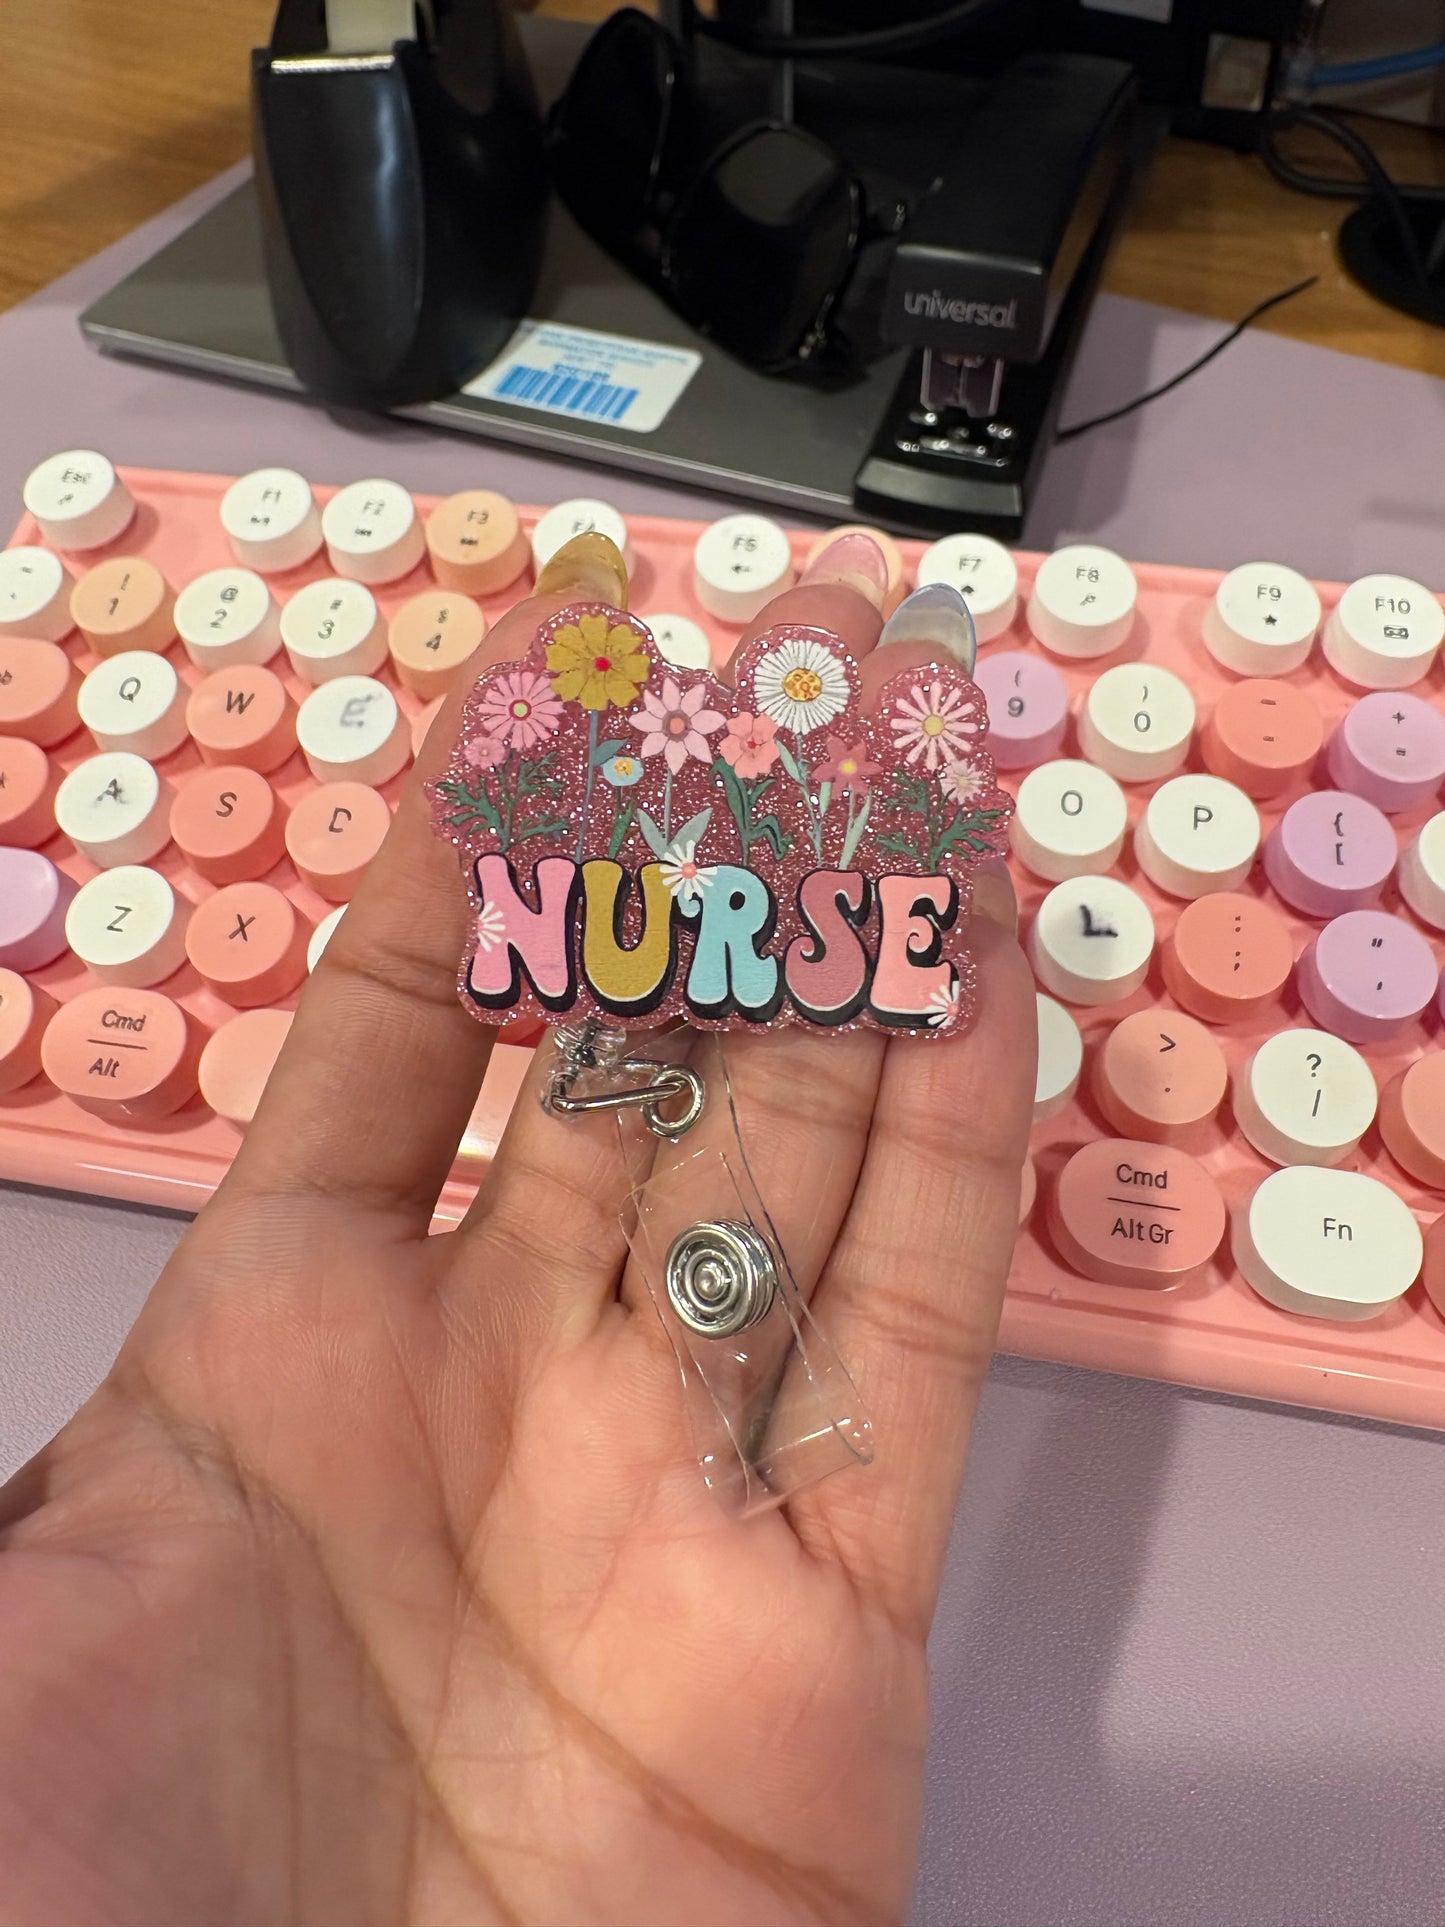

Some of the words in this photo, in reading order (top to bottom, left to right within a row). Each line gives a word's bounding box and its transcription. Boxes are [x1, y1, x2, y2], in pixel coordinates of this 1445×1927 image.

[903, 288, 1017, 329] universal
[466, 510, 490, 526] F3
[958, 557, 982, 572] F7
[1075, 567, 1100, 583] F8
[1257, 585, 1282, 602] F9
[108, 597, 119, 616] 1
[1374, 597, 1411, 615] F10
[209, 608, 228, 629] 2
[317, 620, 335, 640] 3
[118, 676, 142, 703] Q
[1142, 685, 1149, 703] )
[225, 690, 255, 715] W
[1007, 696, 1025, 718] 9
[1391, 711, 1406, 725] +
[215, 791, 238, 818] S
[1193, 806, 1214, 831] P
[1335, 842, 1345, 866] [
[106, 905, 133, 933] Z
[228, 913, 257, 942] X
[1079, 904, 1119, 939] L
[1234, 915, 1241, 933] :
[466, 852, 960, 1029] NURSE
[1233, 951, 1241, 972] ;
[101, 1009, 147, 1033] Cmd
[1159, 1033, 1177, 1053] >
[88, 1057, 120, 1078] Alt
[1306, 1053, 1322, 1078] ?
[1115, 1163, 1168, 1190] Cmd
[1323, 1217, 1353, 1241] Fn
